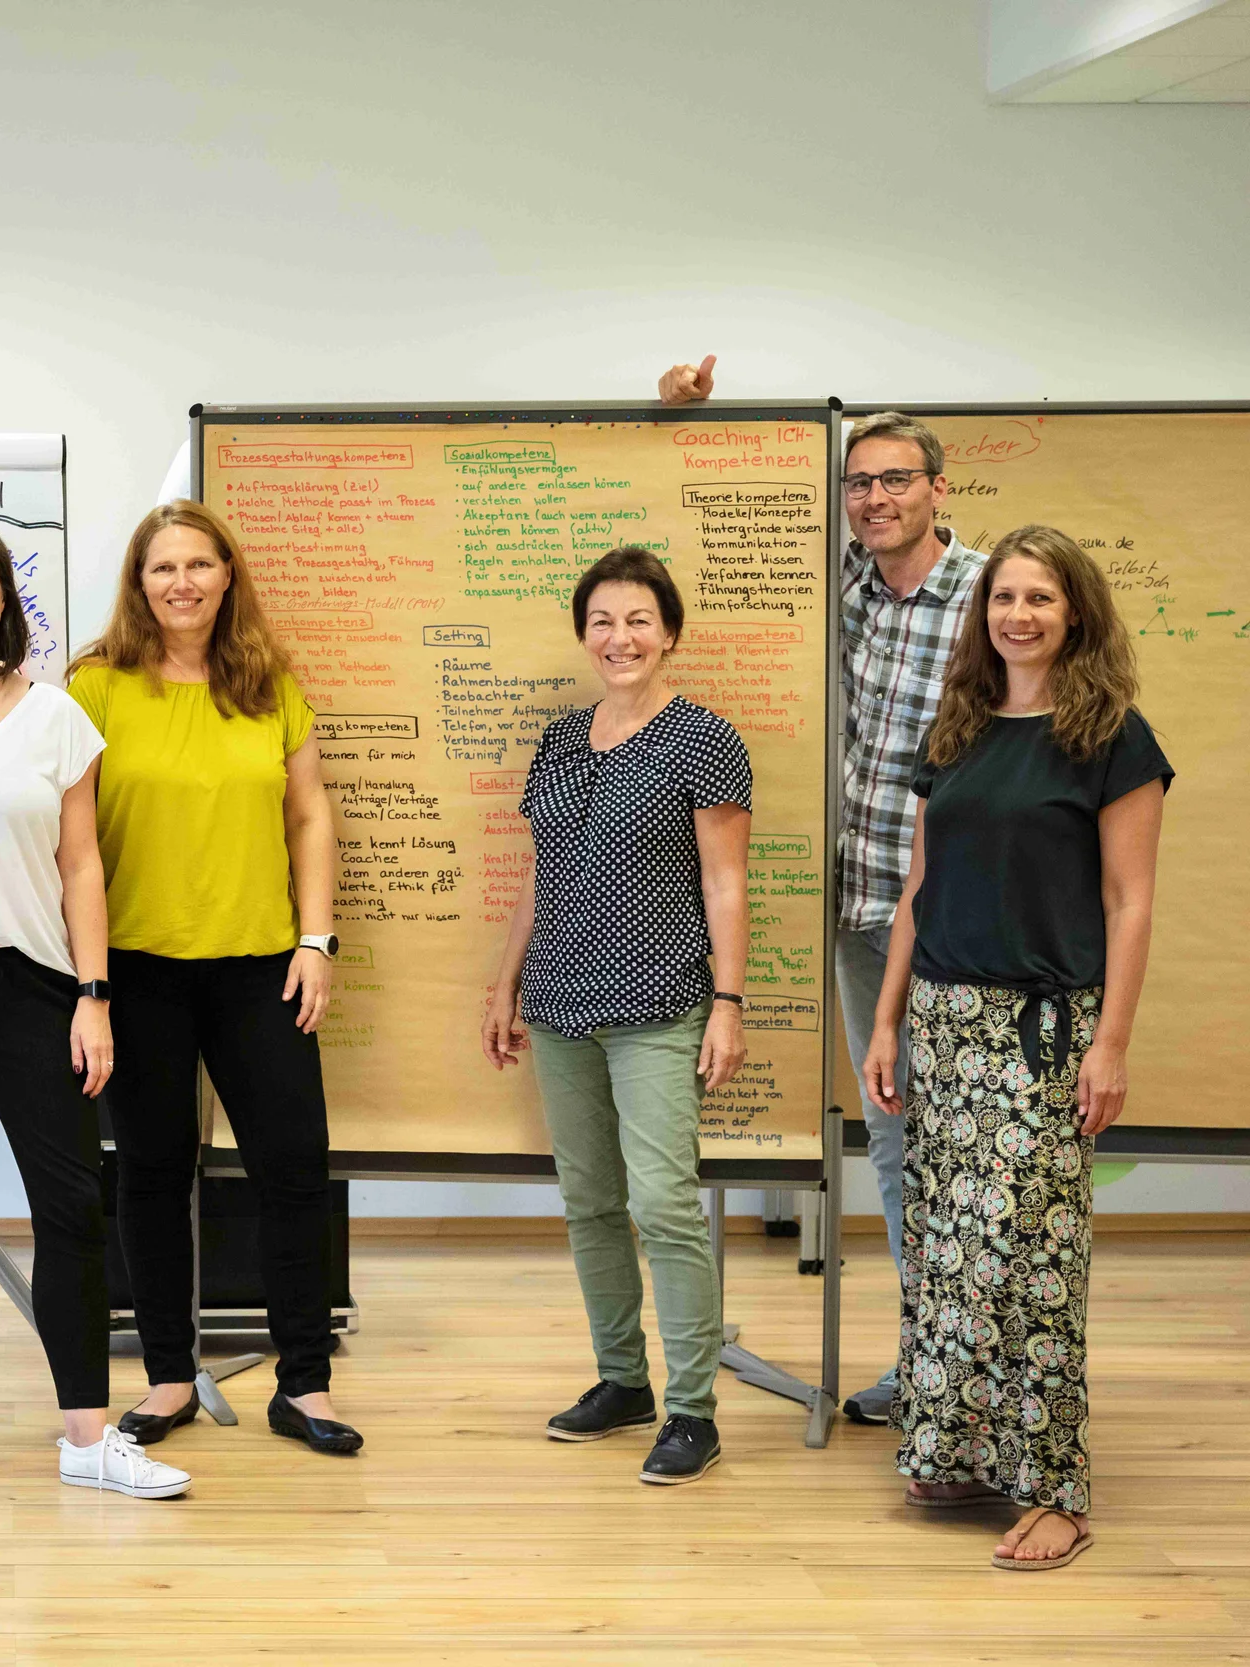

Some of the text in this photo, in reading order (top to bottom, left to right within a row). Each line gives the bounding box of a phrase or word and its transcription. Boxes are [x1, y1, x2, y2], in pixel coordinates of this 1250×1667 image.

[945, 435, 1021, 456] eicher
[222, 449, 407, 468] Prozessgestaltungskompetenz
[451, 447, 551, 462] Sozialkompetenz
[683, 452, 812, 473] Kompetenzen
[462, 465, 577, 479] Einfühlungsvermögen
[237, 479, 380, 495] Auftragsklärung (Ziel)
[462, 477, 631, 491] auf andere einlassen können
[237, 498, 275, 508] Welche
[282, 497, 334, 508] Methode
[339, 498, 372, 511] passt
[397, 495, 435, 506] Prozess
[463, 494, 566, 505] verstehen wollen
[377, 514, 414, 522] steuern
[463, 507, 647, 524] Akzeptanz (auch wenn anders)
[240, 524, 288, 534] (einzelne
[338, 524, 365, 534] alle)
[464, 522, 612, 537] zuhören können (aktiv)
[702, 522, 822, 538] Hintergründe wissen
[240, 543, 366, 556] Standartbestimmung
[464, 540, 488, 550] sich
[496, 539, 563, 550] ausdrücken
[572, 537, 613, 549] können
[248, 556, 434, 572] ewußte Führung
[465, 554, 503, 570] Regeln
[511, 555, 570, 566] einhalten,
[761, 553, 804, 564] Wissen
[1107, 560, 1159, 575] Selbst
[251, 572, 309, 583] aluation
[467, 571, 530, 582] fair sein,
[700, 568, 817, 580] Verfahren kennen
[323, 587, 357, 597] bilden
[464, 587, 560, 600] anpassungsfähig
[699, 583, 814, 601] Führungstheorien
[296, 631, 332, 642] kennen
[346, 634, 402, 642] anwenden
[433, 630, 484, 646] Setting
[690, 630, 796, 641] Feldkompetenz
[307, 649, 347, 657] nutzen
[736, 645, 789, 656] Klienten
[339, 661, 391, 671] Methoden
[442, 658, 492, 672] Räume
[734, 660, 793, 671] Branchen
[298, 674, 396, 686] ethoden kennen
[442, 675, 576, 692] Rahmenbedingungen
[442, 691, 524, 701] Beobachter
[442, 705, 504, 716] Teilnehmer
[741, 705, 788, 715] kennen
[314, 720, 411, 738] ungskompetenz
[442, 720, 492, 732] Telefon,
[444, 736, 507, 752] Verbindung
[319, 750, 416, 761] kennen für mich
[446, 748, 502, 765] (Training)
[370, 837, 406, 848] kennt
[412, 837, 456, 853] Lösung
[341, 853, 399, 864] Coachee
[343, 869, 370, 878] dem
[380, 869, 429, 878] anderen
[772, 869, 818, 883] knüpfen
[388, 882, 425, 891] Ethik
[432, 881, 457, 893] für
[771, 885, 822, 897] aufbauen
[332, 897, 386, 911] oaching
[366, 912, 396, 920] nicht
[485, 913, 507, 922] sich
[790, 946, 813, 954] und
[790, 976, 815, 985] sein
